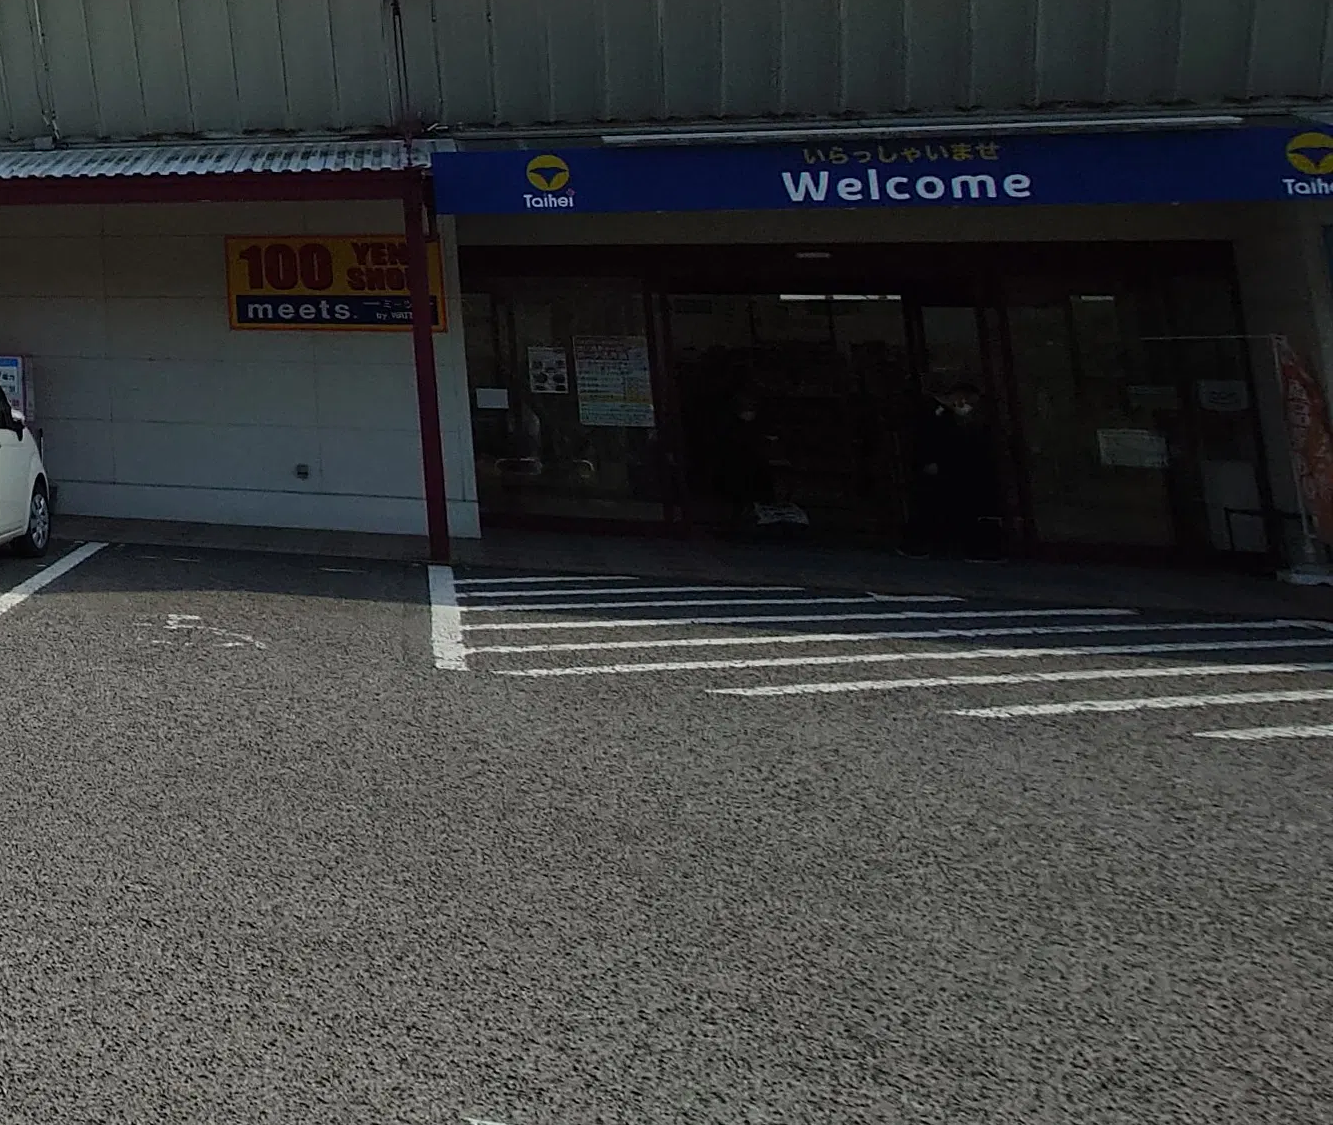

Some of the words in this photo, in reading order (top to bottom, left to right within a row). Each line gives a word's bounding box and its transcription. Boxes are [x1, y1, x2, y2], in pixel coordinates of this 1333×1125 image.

[802, 141, 1000, 164] いらっしゃいませ
[781, 168, 1033, 202] Welcome
[523, 188, 575, 208] Taihei
[351, 242, 409, 266] YEN
[239, 243, 333, 290] 100
[347, 267, 411, 291] SHO
[247, 299, 359, 320] meets.
